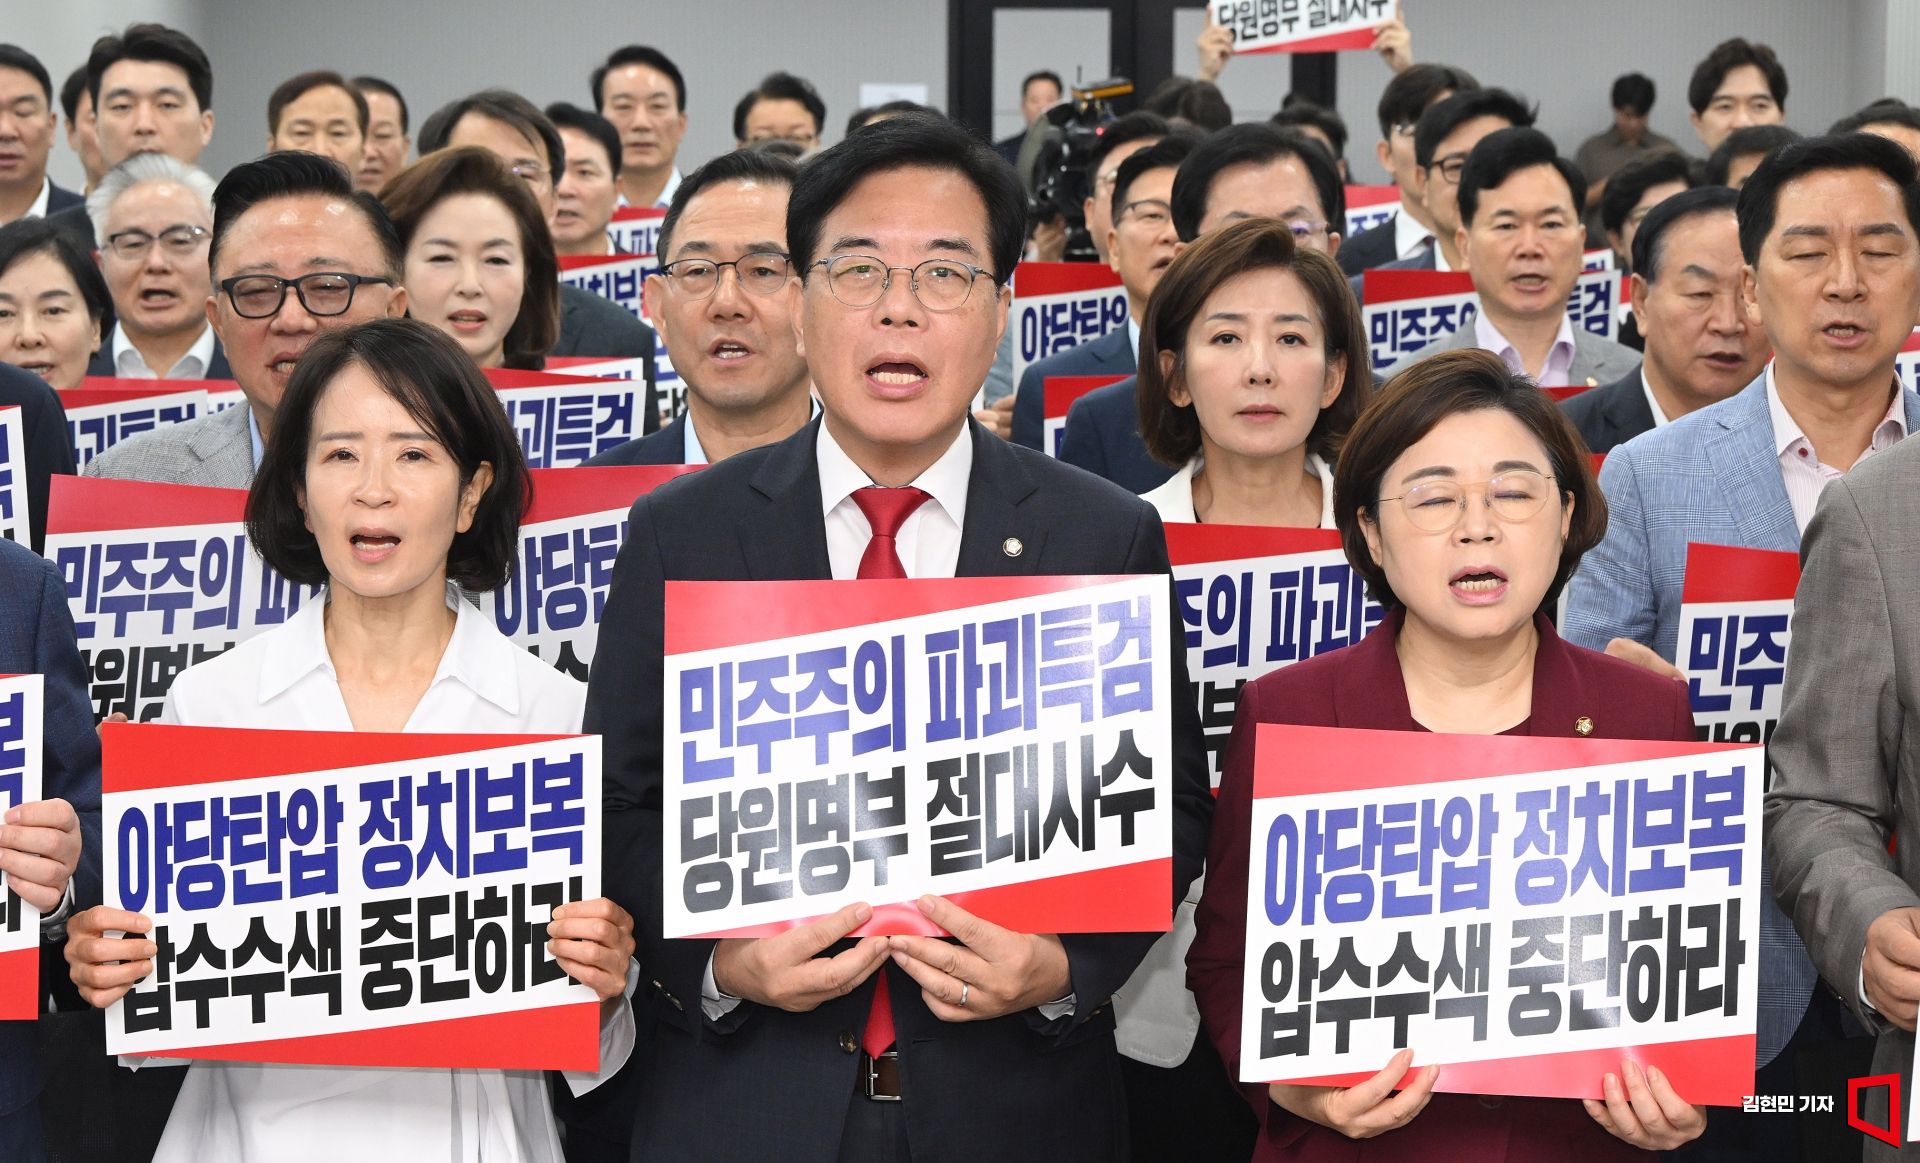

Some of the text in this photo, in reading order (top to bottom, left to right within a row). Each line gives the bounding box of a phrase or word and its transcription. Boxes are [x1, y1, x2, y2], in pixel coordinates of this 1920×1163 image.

[1371, 302, 1477, 369] 민주주
[505, 392, 634, 468] 괴특검
[57, 535, 246, 639] 민주주의
[679, 634, 907, 785] 민주주의
[925, 595, 1153, 744] 파괴특검
[118, 785, 344, 913] 야당탄압
[359, 753, 585, 889] 정치보복
[680, 729, 1156, 914] 당원명부 절대사수
[1265, 766, 1745, 926] 야당탄압 정치보복
[1259, 898, 1746, 1060] 압수수색 중단하라
